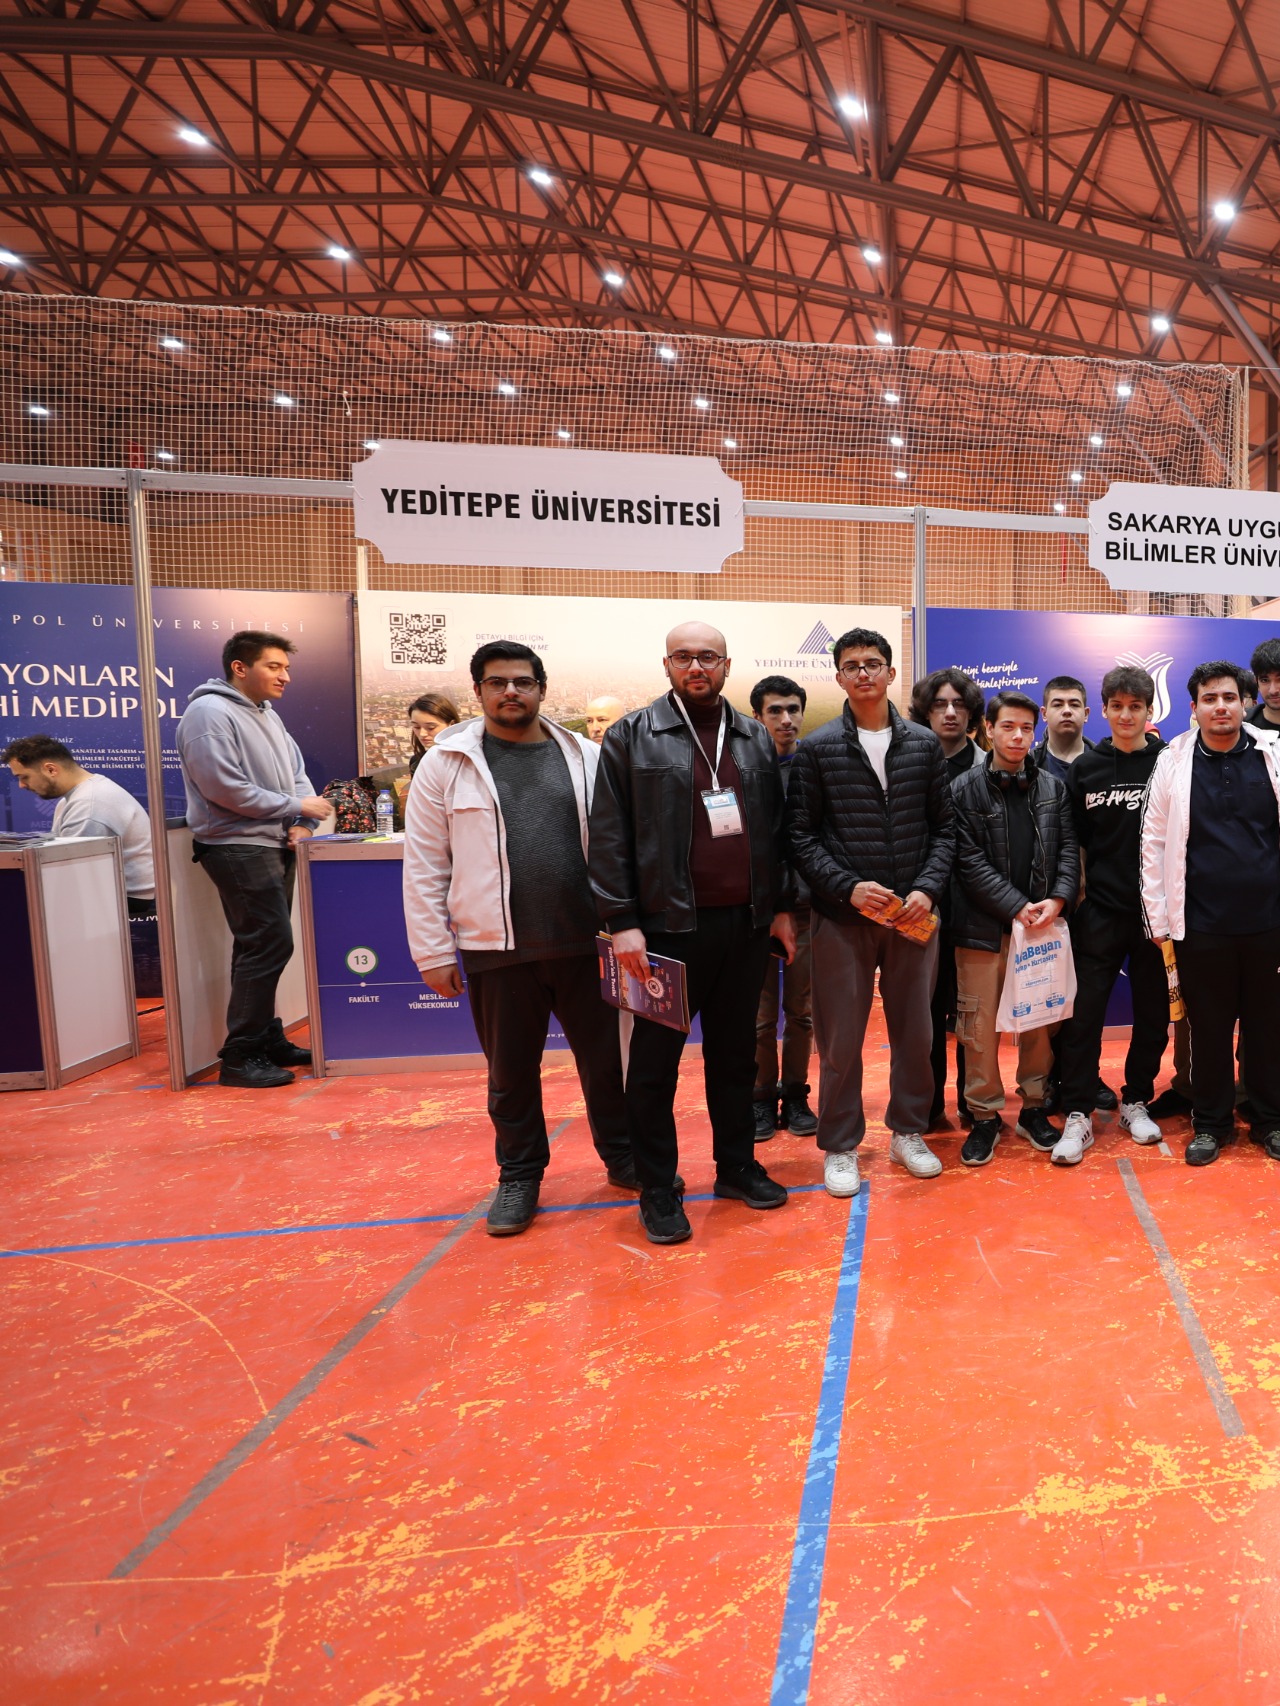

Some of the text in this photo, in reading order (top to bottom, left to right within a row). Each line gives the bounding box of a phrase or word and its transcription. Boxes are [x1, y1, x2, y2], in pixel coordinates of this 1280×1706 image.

[380, 484, 721, 528] YEDİTEPE ÜNİVERSİTESİ
[1107, 511, 1222, 536] SAKARYA
[1104, 537, 1217, 565] BİLİMLER
[92, 614, 305, 633] ÜNVERSİTESİ
[754, 657, 809, 669] YEDİTEPE
[981, 660, 1019, 676] beceriyle
[0, 663, 175, 688] YONLARN
[101, 762, 135, 770] BİLİMLERİ
[353, 954, 369, 966] 13
[348, 994, 380, 1004] FAKÜLTE
[408, 1000, 459, 1010] YÜKSEKOKULU
